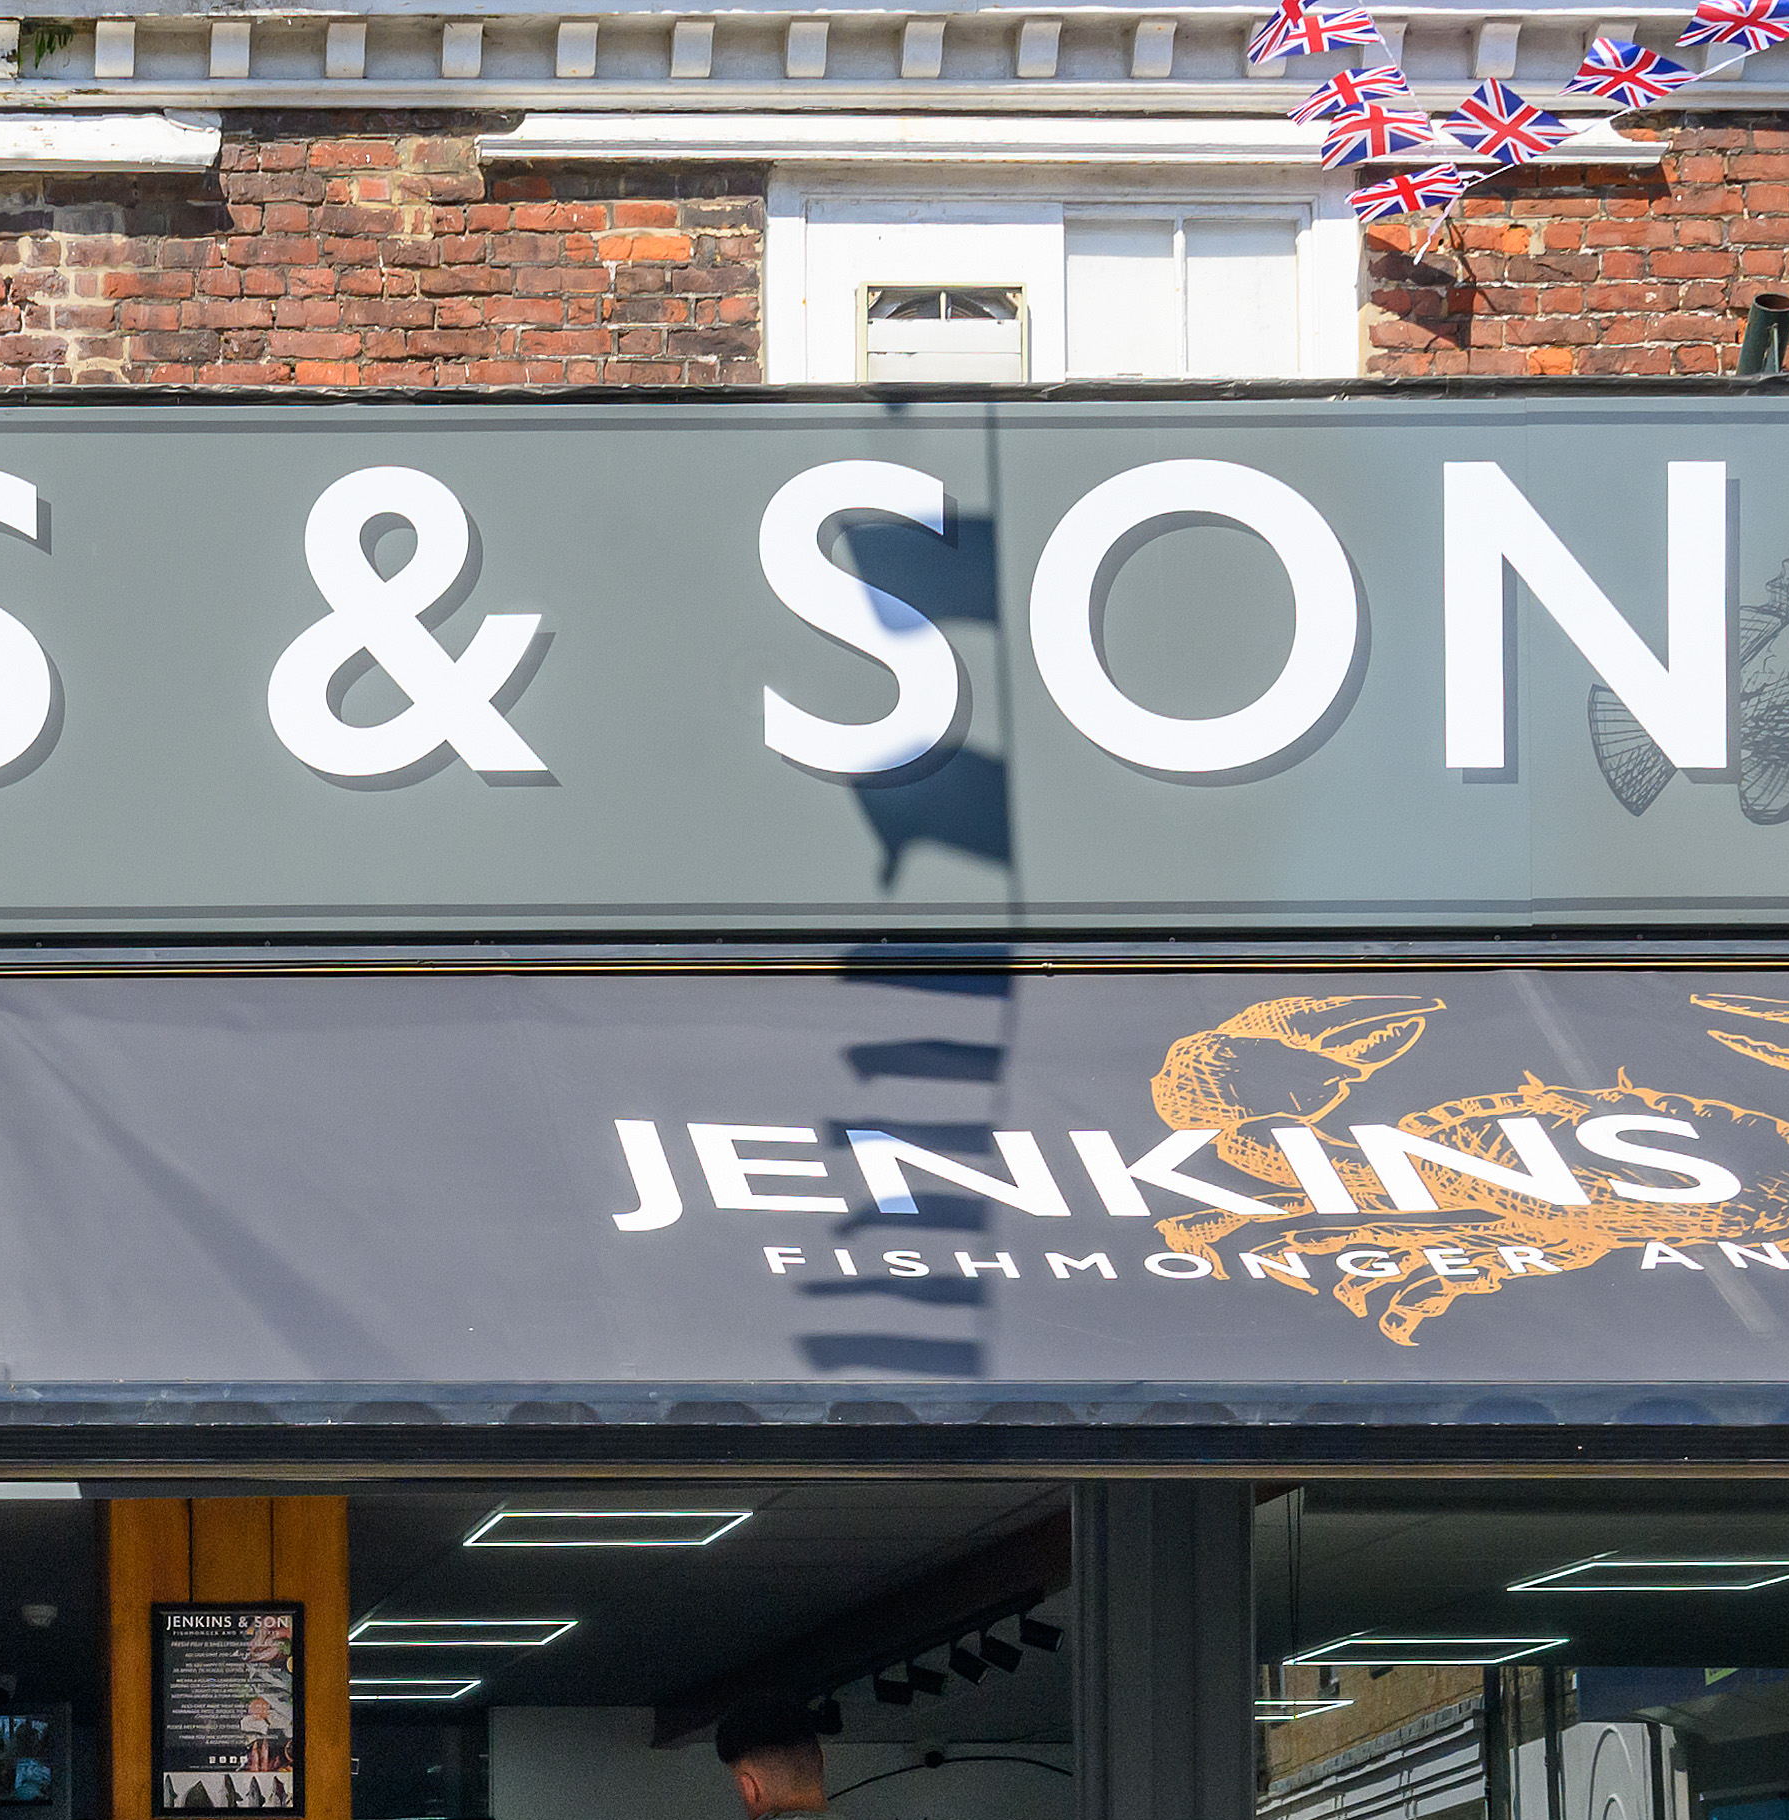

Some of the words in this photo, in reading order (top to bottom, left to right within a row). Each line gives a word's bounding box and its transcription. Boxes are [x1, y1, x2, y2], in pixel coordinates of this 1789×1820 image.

[266, 466, 547, 777] &
[758, 457, 1728, 774] SON
[612, 1114, 1743, 1233] JENKINS
[763, 1245, 1564, 1282] FISHMONGER
[166, 1615, 232, 1631] JENKINS
[238, 1616, 248, 1628] &
[254, 1615, 289, 1628] SON
